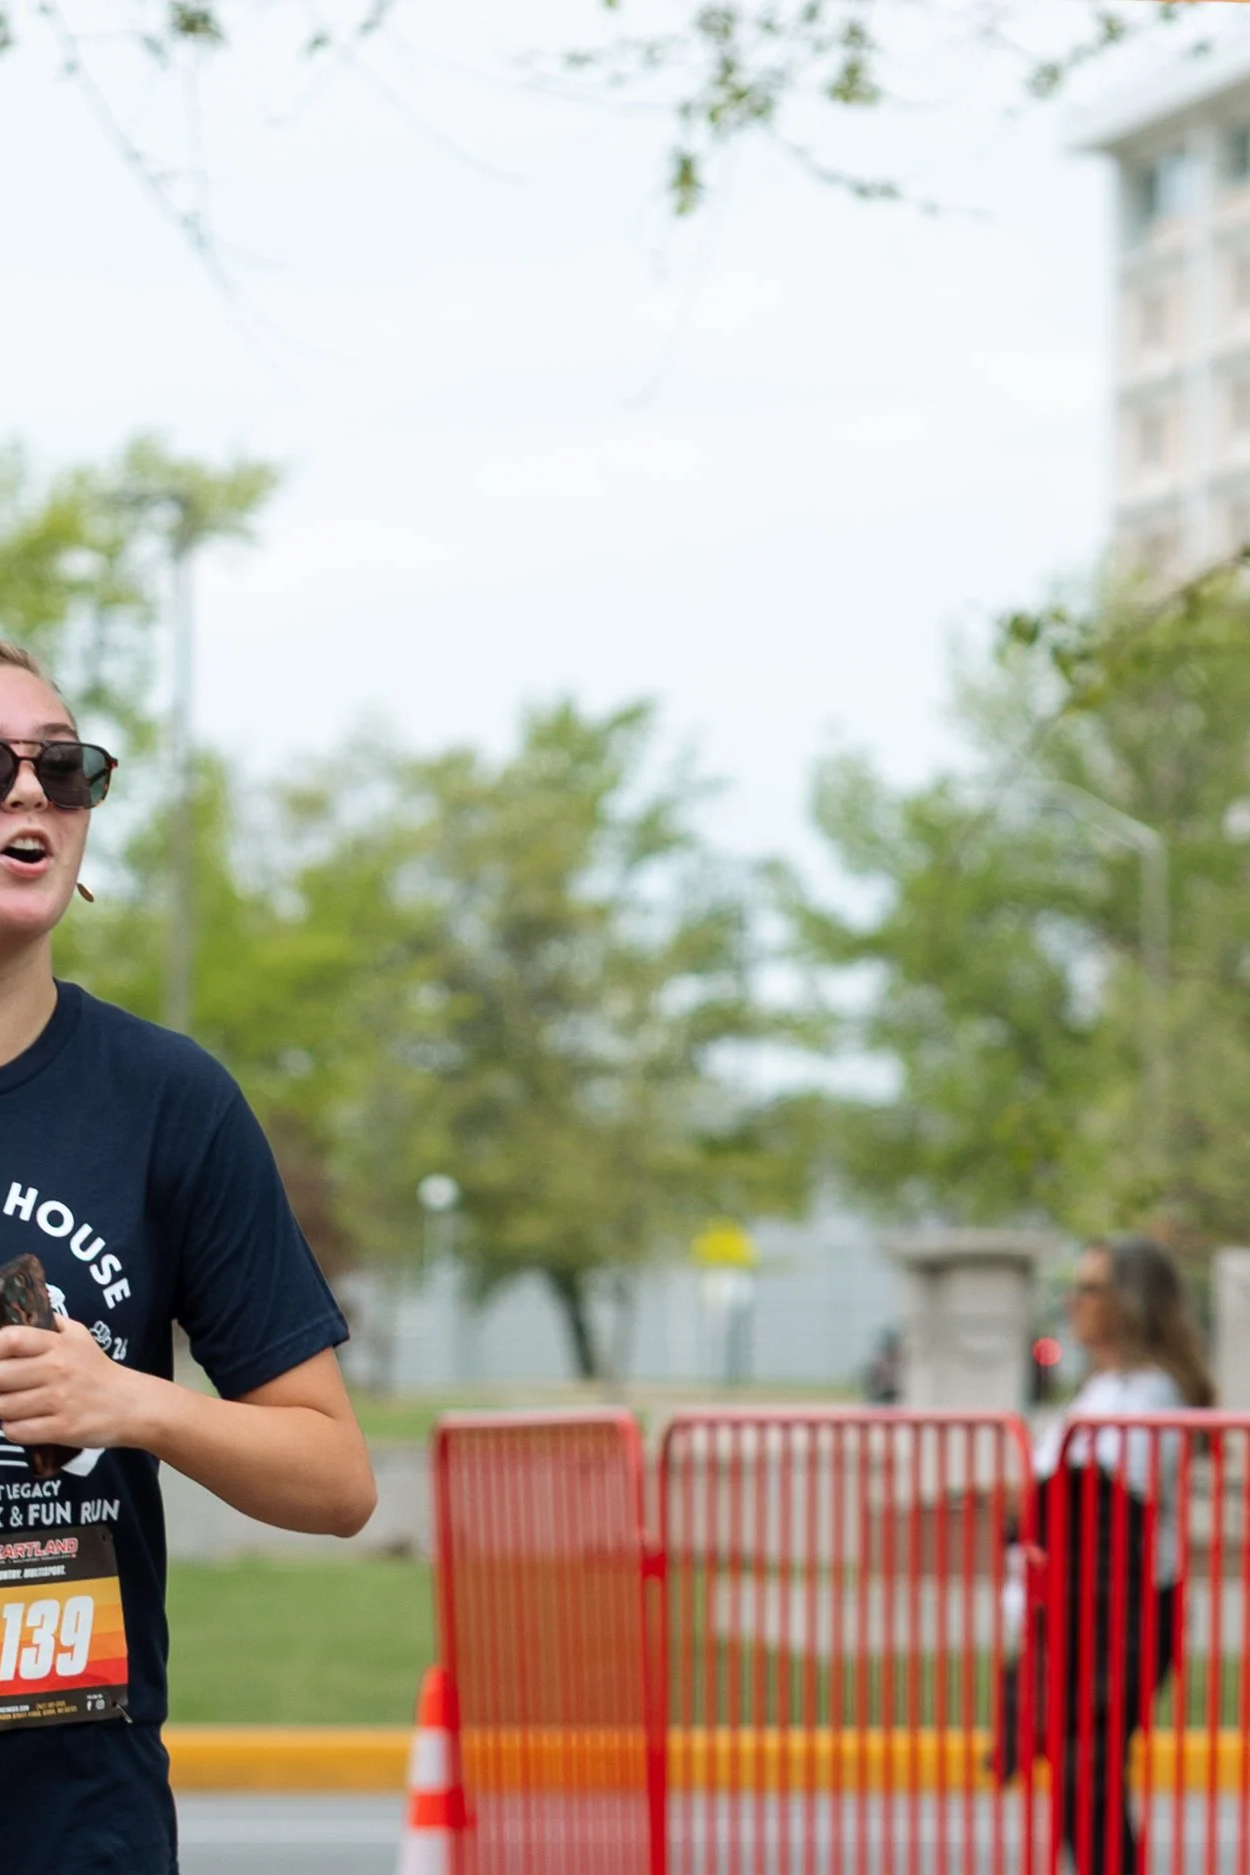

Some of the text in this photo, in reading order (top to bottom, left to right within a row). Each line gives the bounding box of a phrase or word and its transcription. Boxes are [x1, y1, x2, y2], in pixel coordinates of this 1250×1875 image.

[2, 1182, 131, 1309] HOUSE
[6, 1479, 62, 1500] LEGACY
[9, 1505, 23, 1527] &
[27, 1501, 72, 1526] FUN
[80, 1499, 120, 1525] RUN
